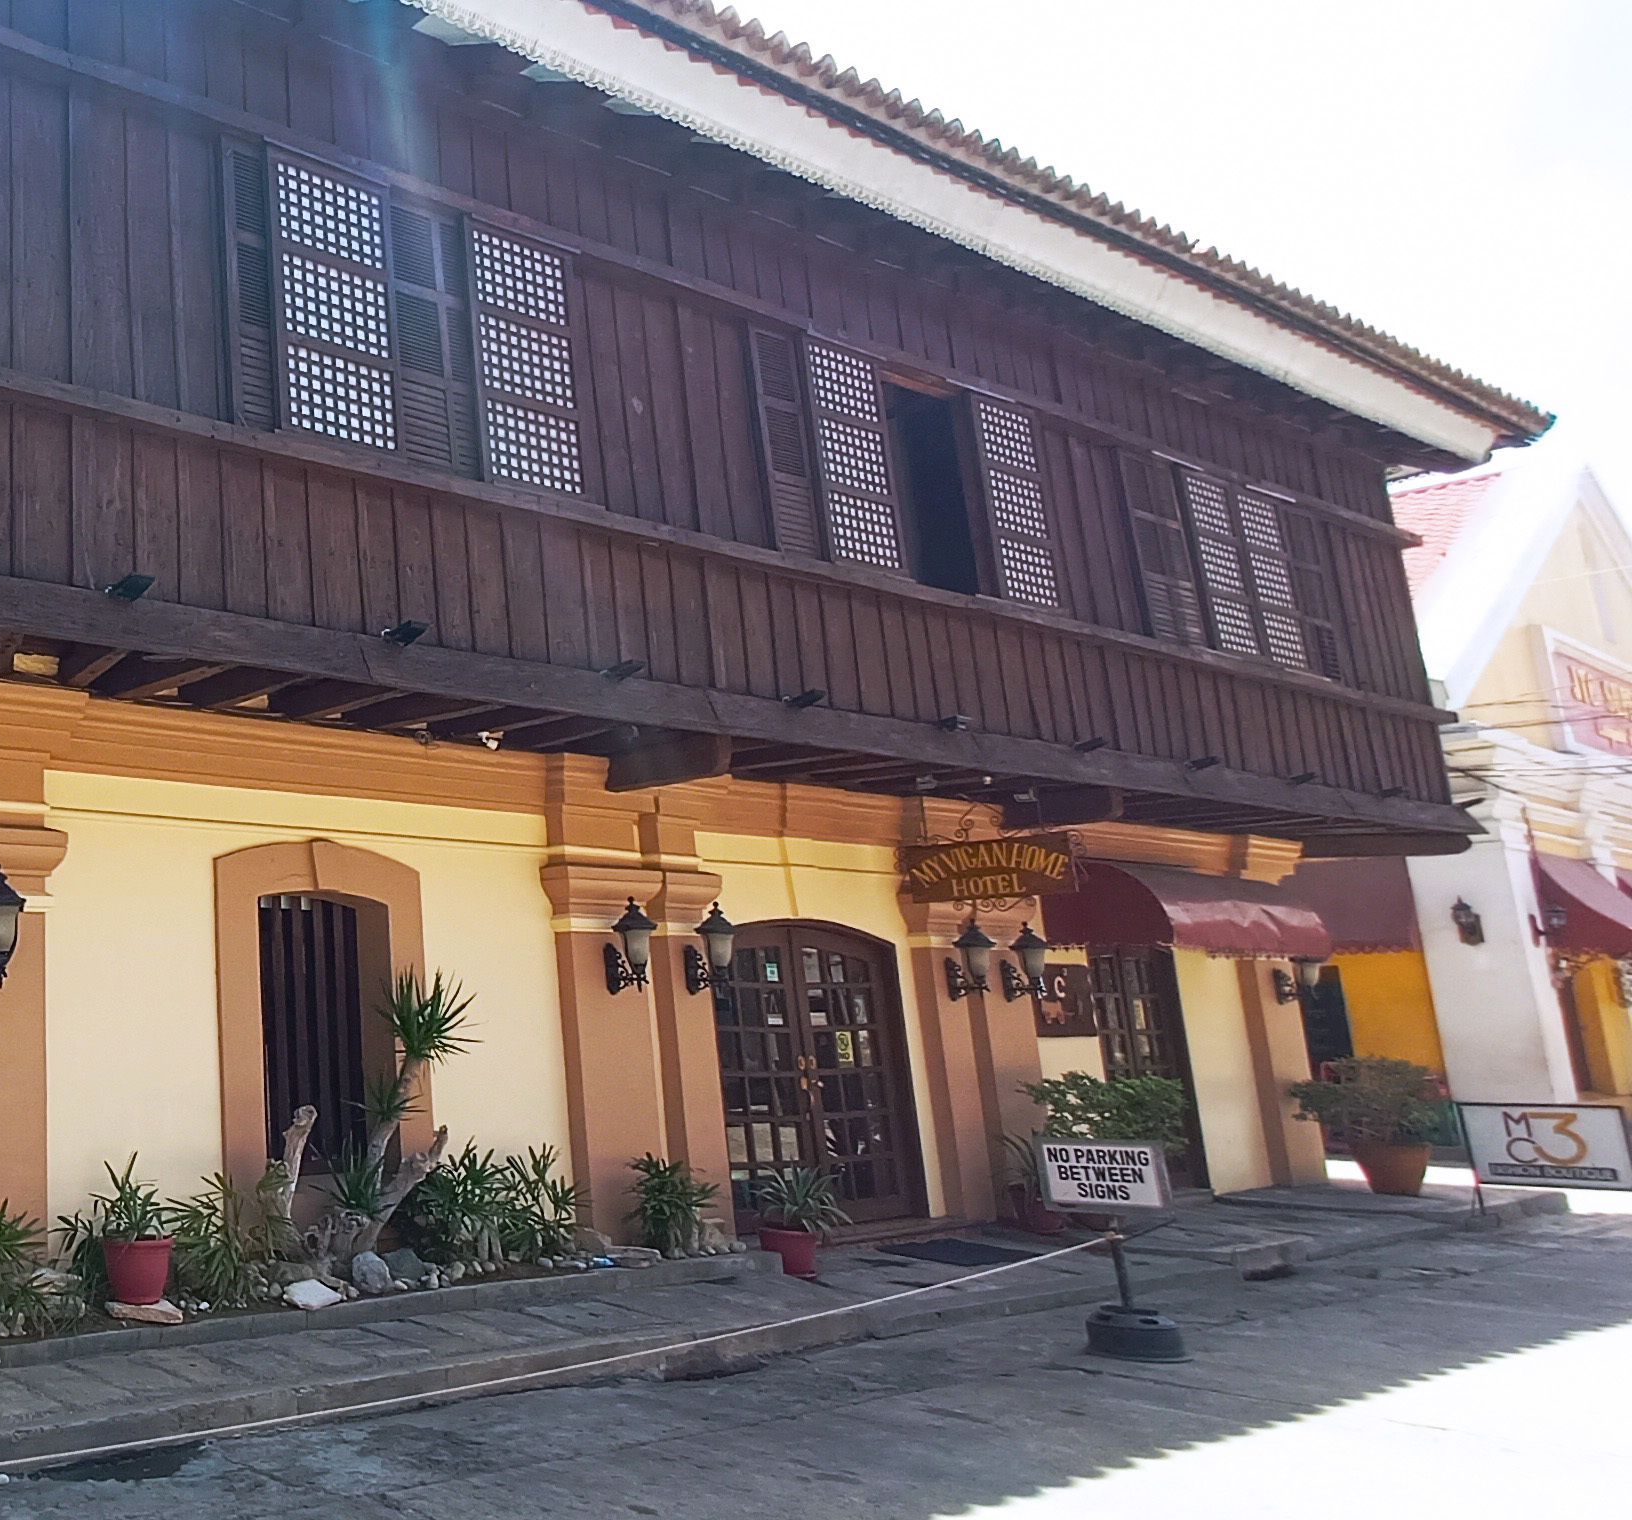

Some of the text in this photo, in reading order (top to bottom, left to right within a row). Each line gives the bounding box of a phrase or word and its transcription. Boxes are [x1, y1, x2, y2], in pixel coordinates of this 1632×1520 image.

[911, 841, 1068, 888] MY VIGAN HOME
[951, 873, 1027, 897] HOTEL
[1045, 1146, 1150, 1167] NO PARKING
[1057, 1164, 1145, 1184] BETWEEN
[1076, 1182, 1131, 1201] SIGNS
